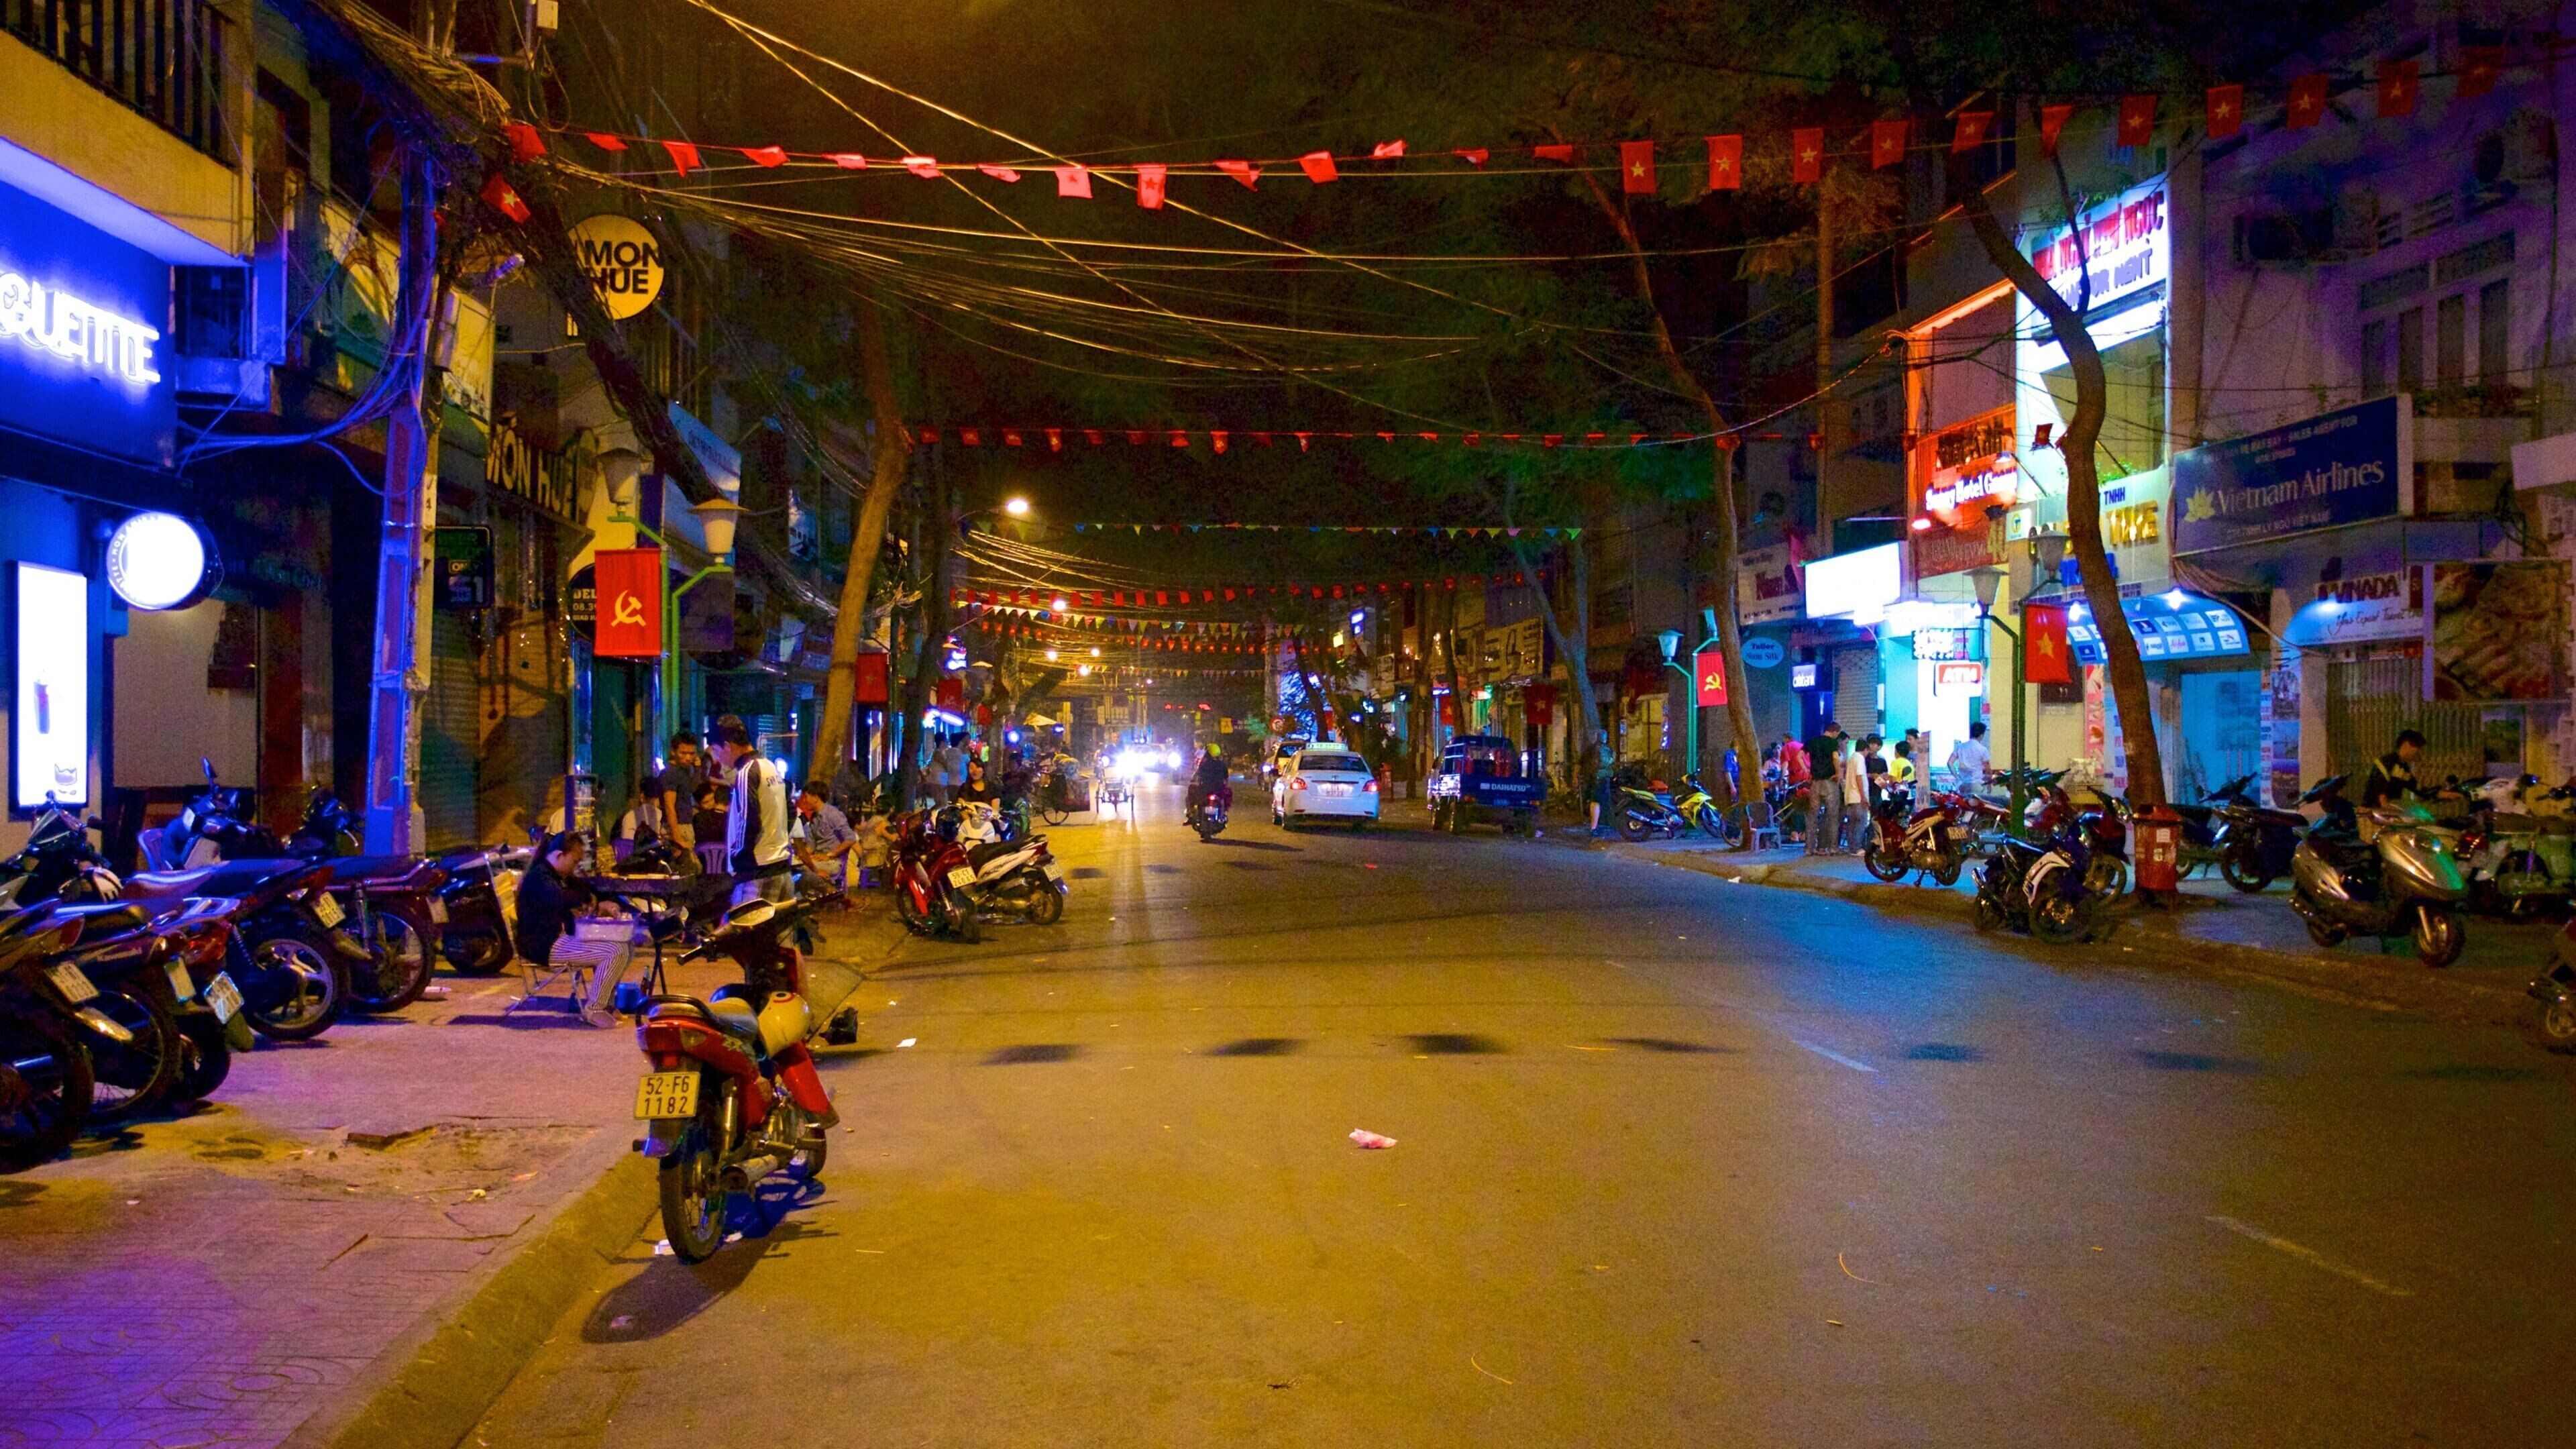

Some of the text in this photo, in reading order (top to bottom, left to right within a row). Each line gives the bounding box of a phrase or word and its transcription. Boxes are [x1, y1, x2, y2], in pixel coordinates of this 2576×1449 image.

[585, 239, 663, 268] MON
[589, 267, 649, 294] HUE
[2104, 486, 2126, 505] TNHH
[2216, 460, 2385, 516] Vietnam Airlines
[1943, 668, 1978, 684] ATM
[1491, 782, 1527, 792] DAIHATSU
[645, 1075, 690, 1095] 52-F6
[644, 1095, 688, 1116] 1182
